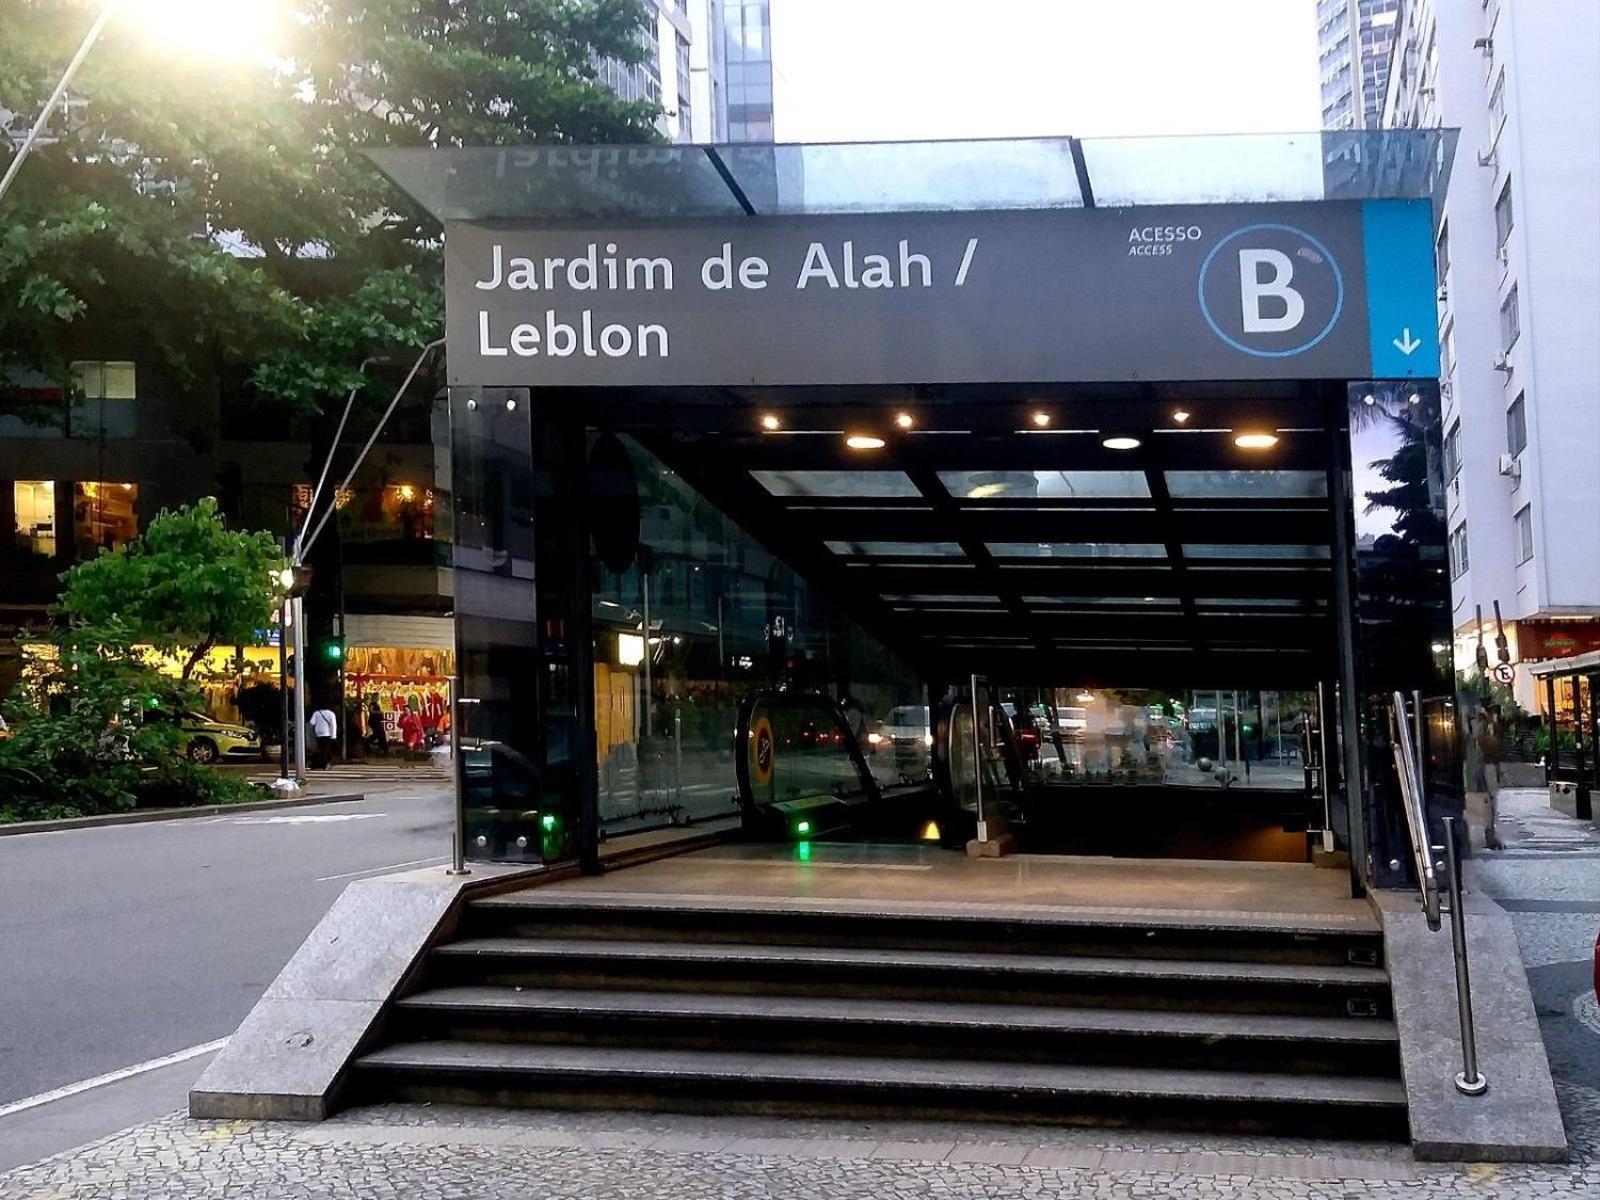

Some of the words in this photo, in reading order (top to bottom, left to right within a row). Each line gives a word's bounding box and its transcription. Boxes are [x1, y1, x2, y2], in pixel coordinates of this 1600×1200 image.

[1128, 226, 1202, 242] ACESSO
[1128, 244, 1173, 256] ACCESS
[475, 243, 673, 290] Jardim
[701, 242, 769, 289] de
[796, 239, 932, 289] Alah
[1239, 248, 1306, 333] B
[479, 310, 670, 357] Leblon
